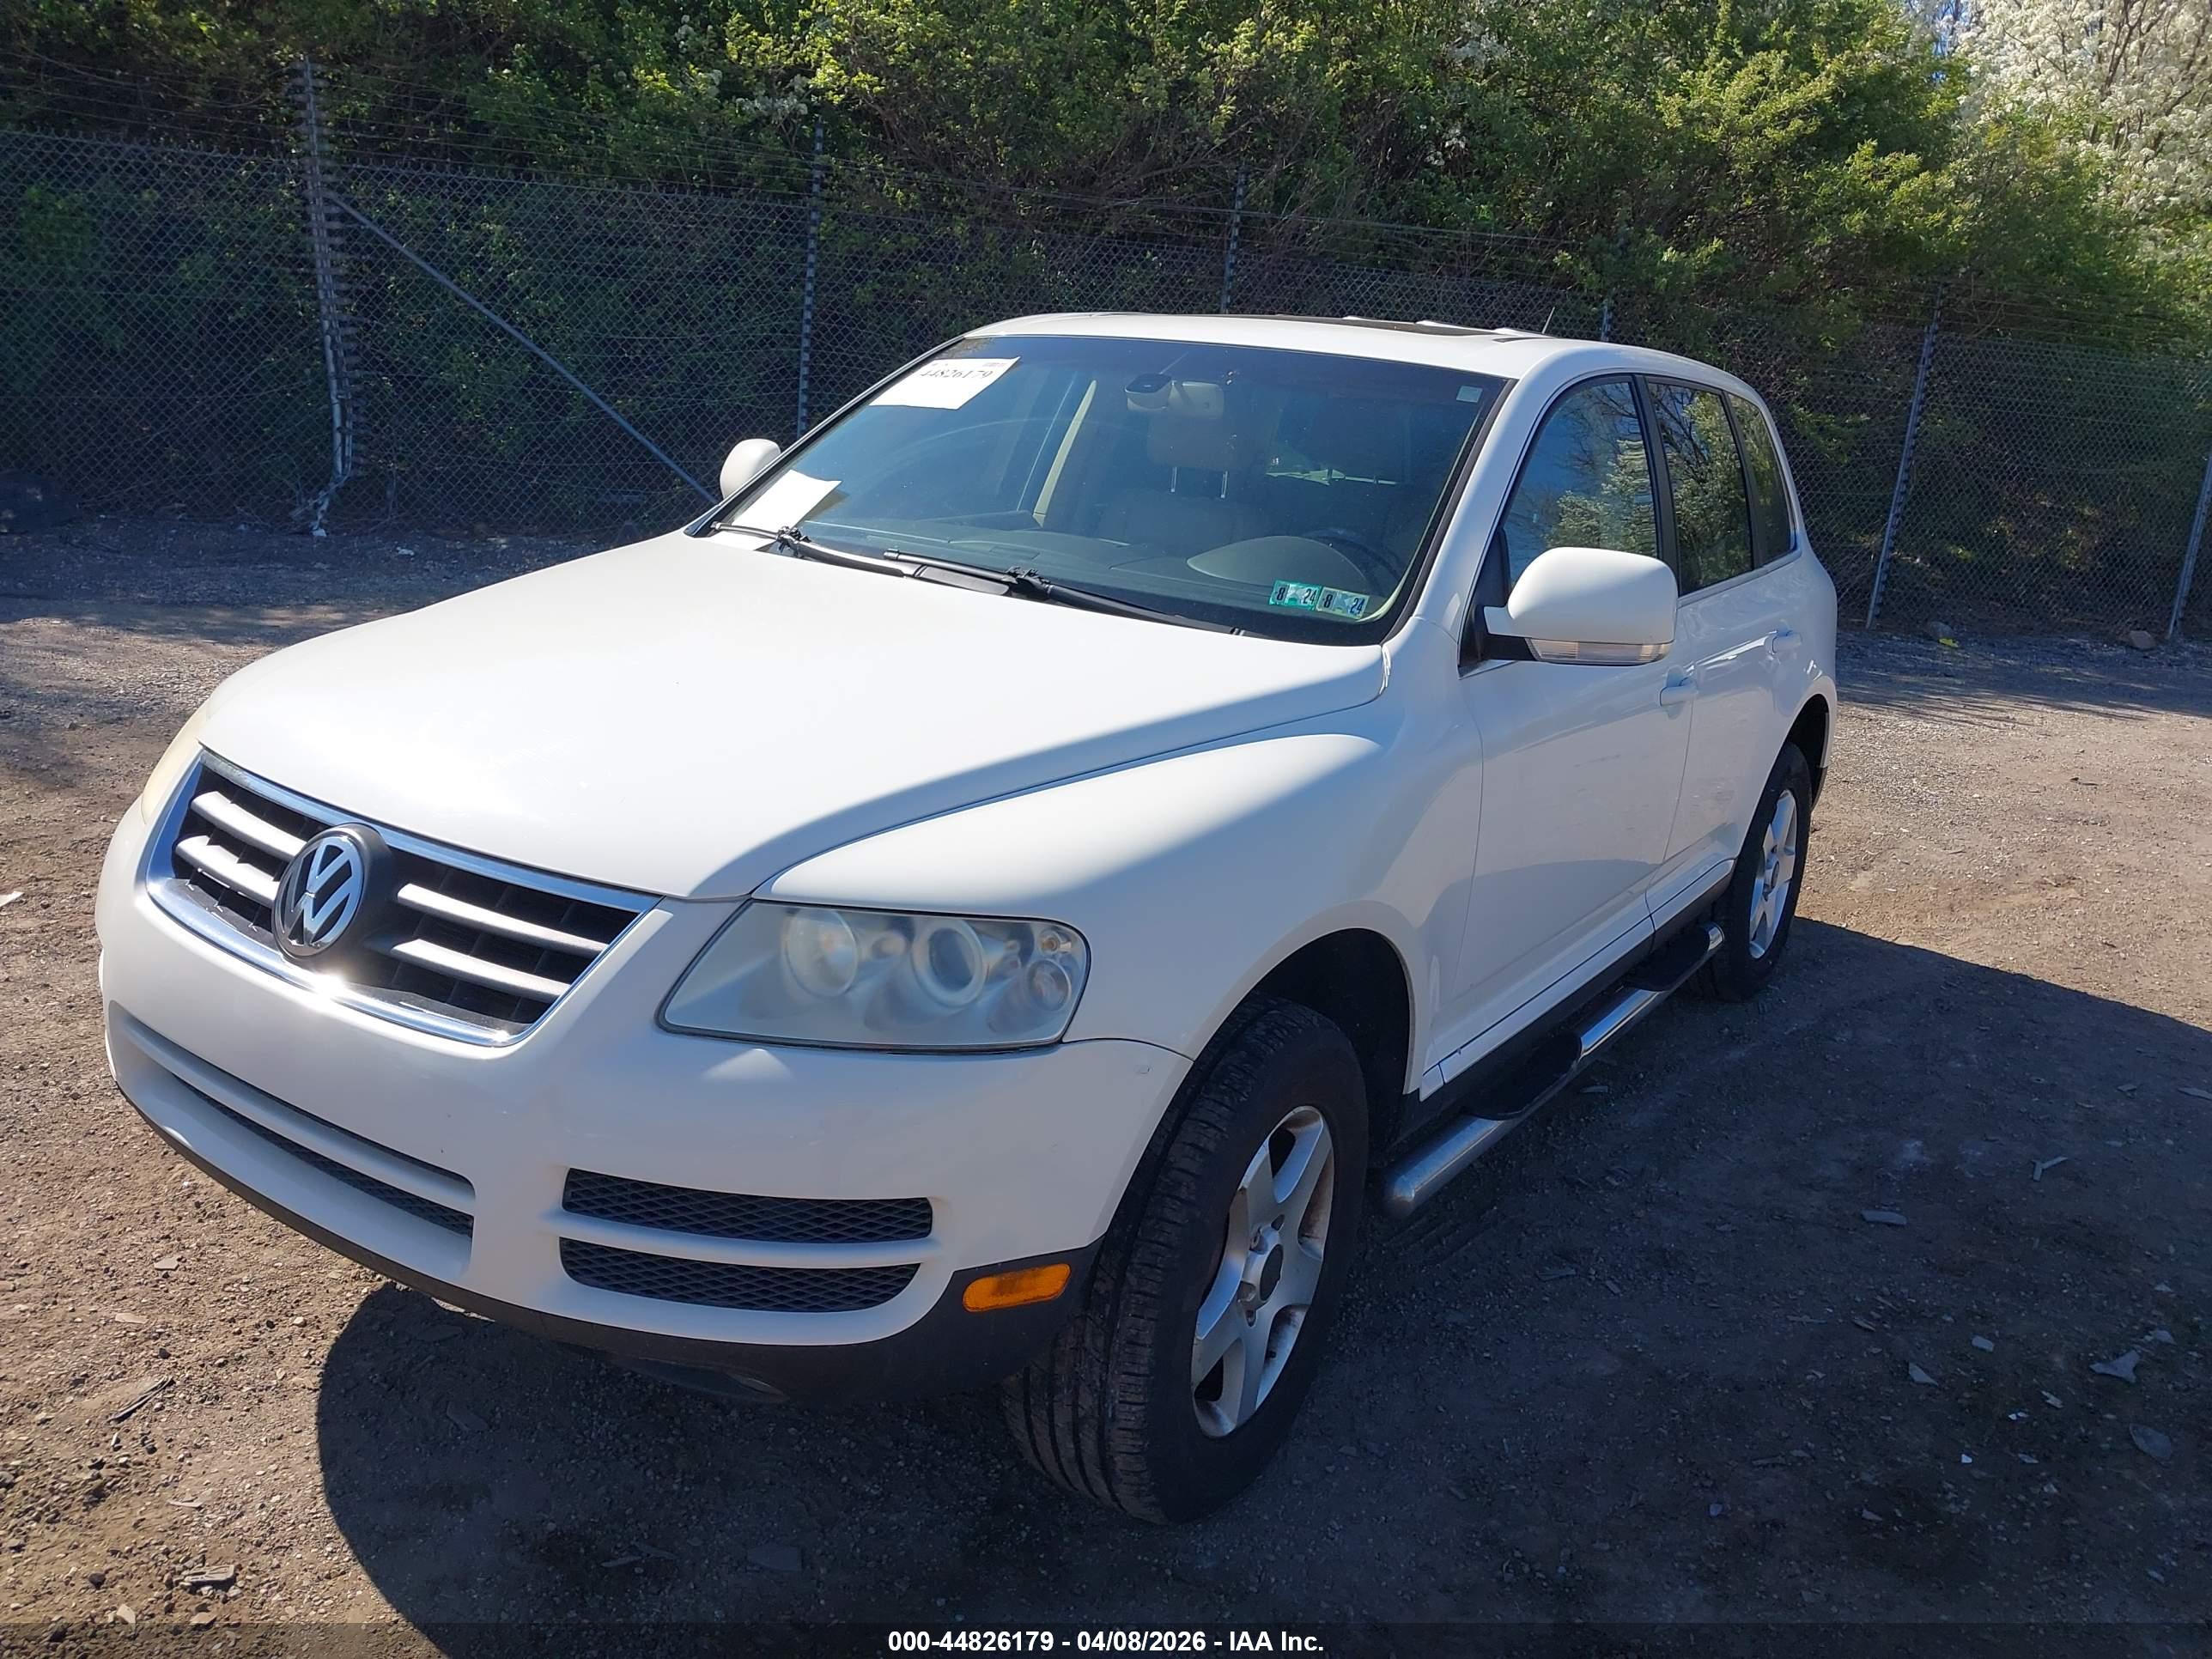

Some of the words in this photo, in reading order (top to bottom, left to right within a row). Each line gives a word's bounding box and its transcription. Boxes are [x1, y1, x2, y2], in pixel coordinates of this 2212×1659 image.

[1303, 588, 1317, 605] 24
[1349, 598, 1365, 615] 24
[275, 836, 364, 956] VW
